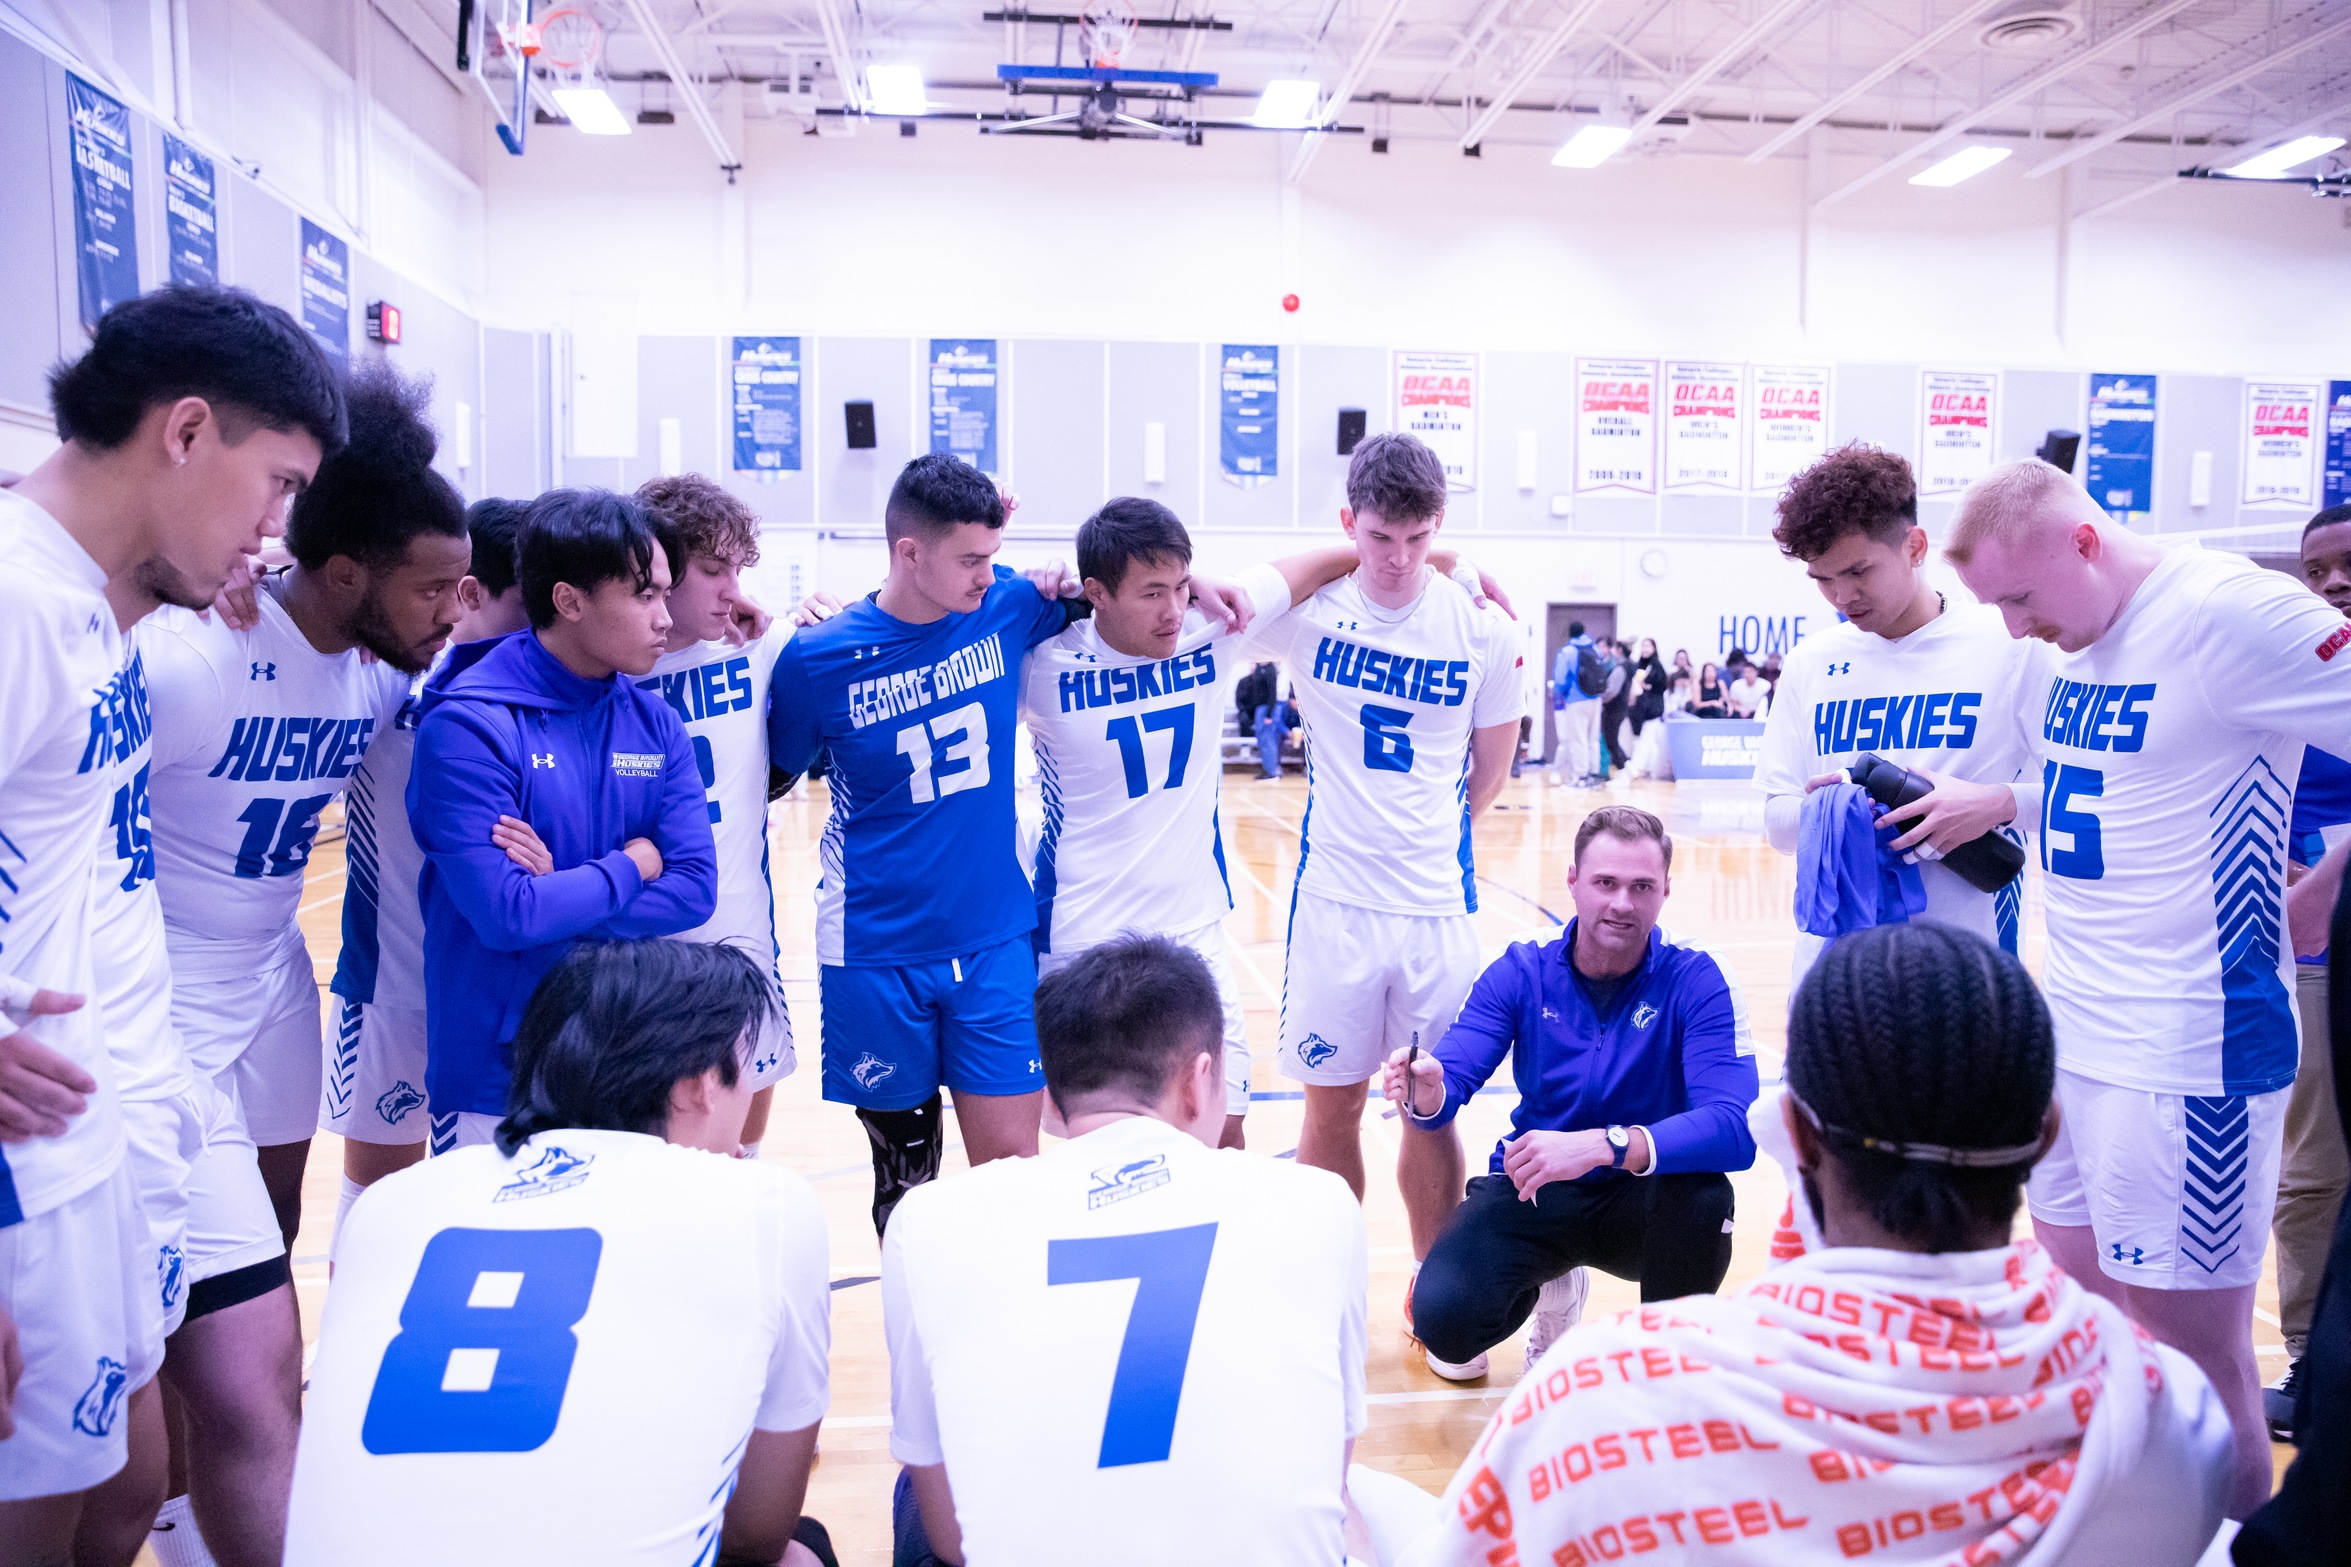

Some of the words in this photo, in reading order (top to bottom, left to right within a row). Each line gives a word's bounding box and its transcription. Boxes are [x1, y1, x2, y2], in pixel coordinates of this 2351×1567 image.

[1675, 383, 1735, 402] OCAA
[1761, 387, 1821, 405] OCAA
[1931, 393, 1988, 412] OCAA
[2256, 404, 2310, 422] OCAA
[1719, 615, 1807, 655] HOME
[848, 665, 932, 730] GEORGE
[933, 631, 1005, 700] BROWN
[1059, 642, 1216, 714] HUSKIES
[1313, 636, 1469, 707] HUSKIES
[207, 716, 374, 782] HUSKIES
[1360, 703, 1415, 774] 6
[1814, 692, 1983, 756] HUSKIES
[2043, 676, 2157, 753] USKIES
[614, 768, 659, 778] VOLLEYBALL
[616, 759, 662, 769] HUSKIES
[897, 701, 990, 804] 13
[1105, 702, 1195, 799] 17
[2040, 758, 2105, 880] 15
[361, 1226, 604, 1456] 8
[1047, 1221, 1219, 1469] 7
[1527, 1418, 1781, 1503] BIOSTEEL
[1551, 1497, 1811, 1567] BIOSTEEL
